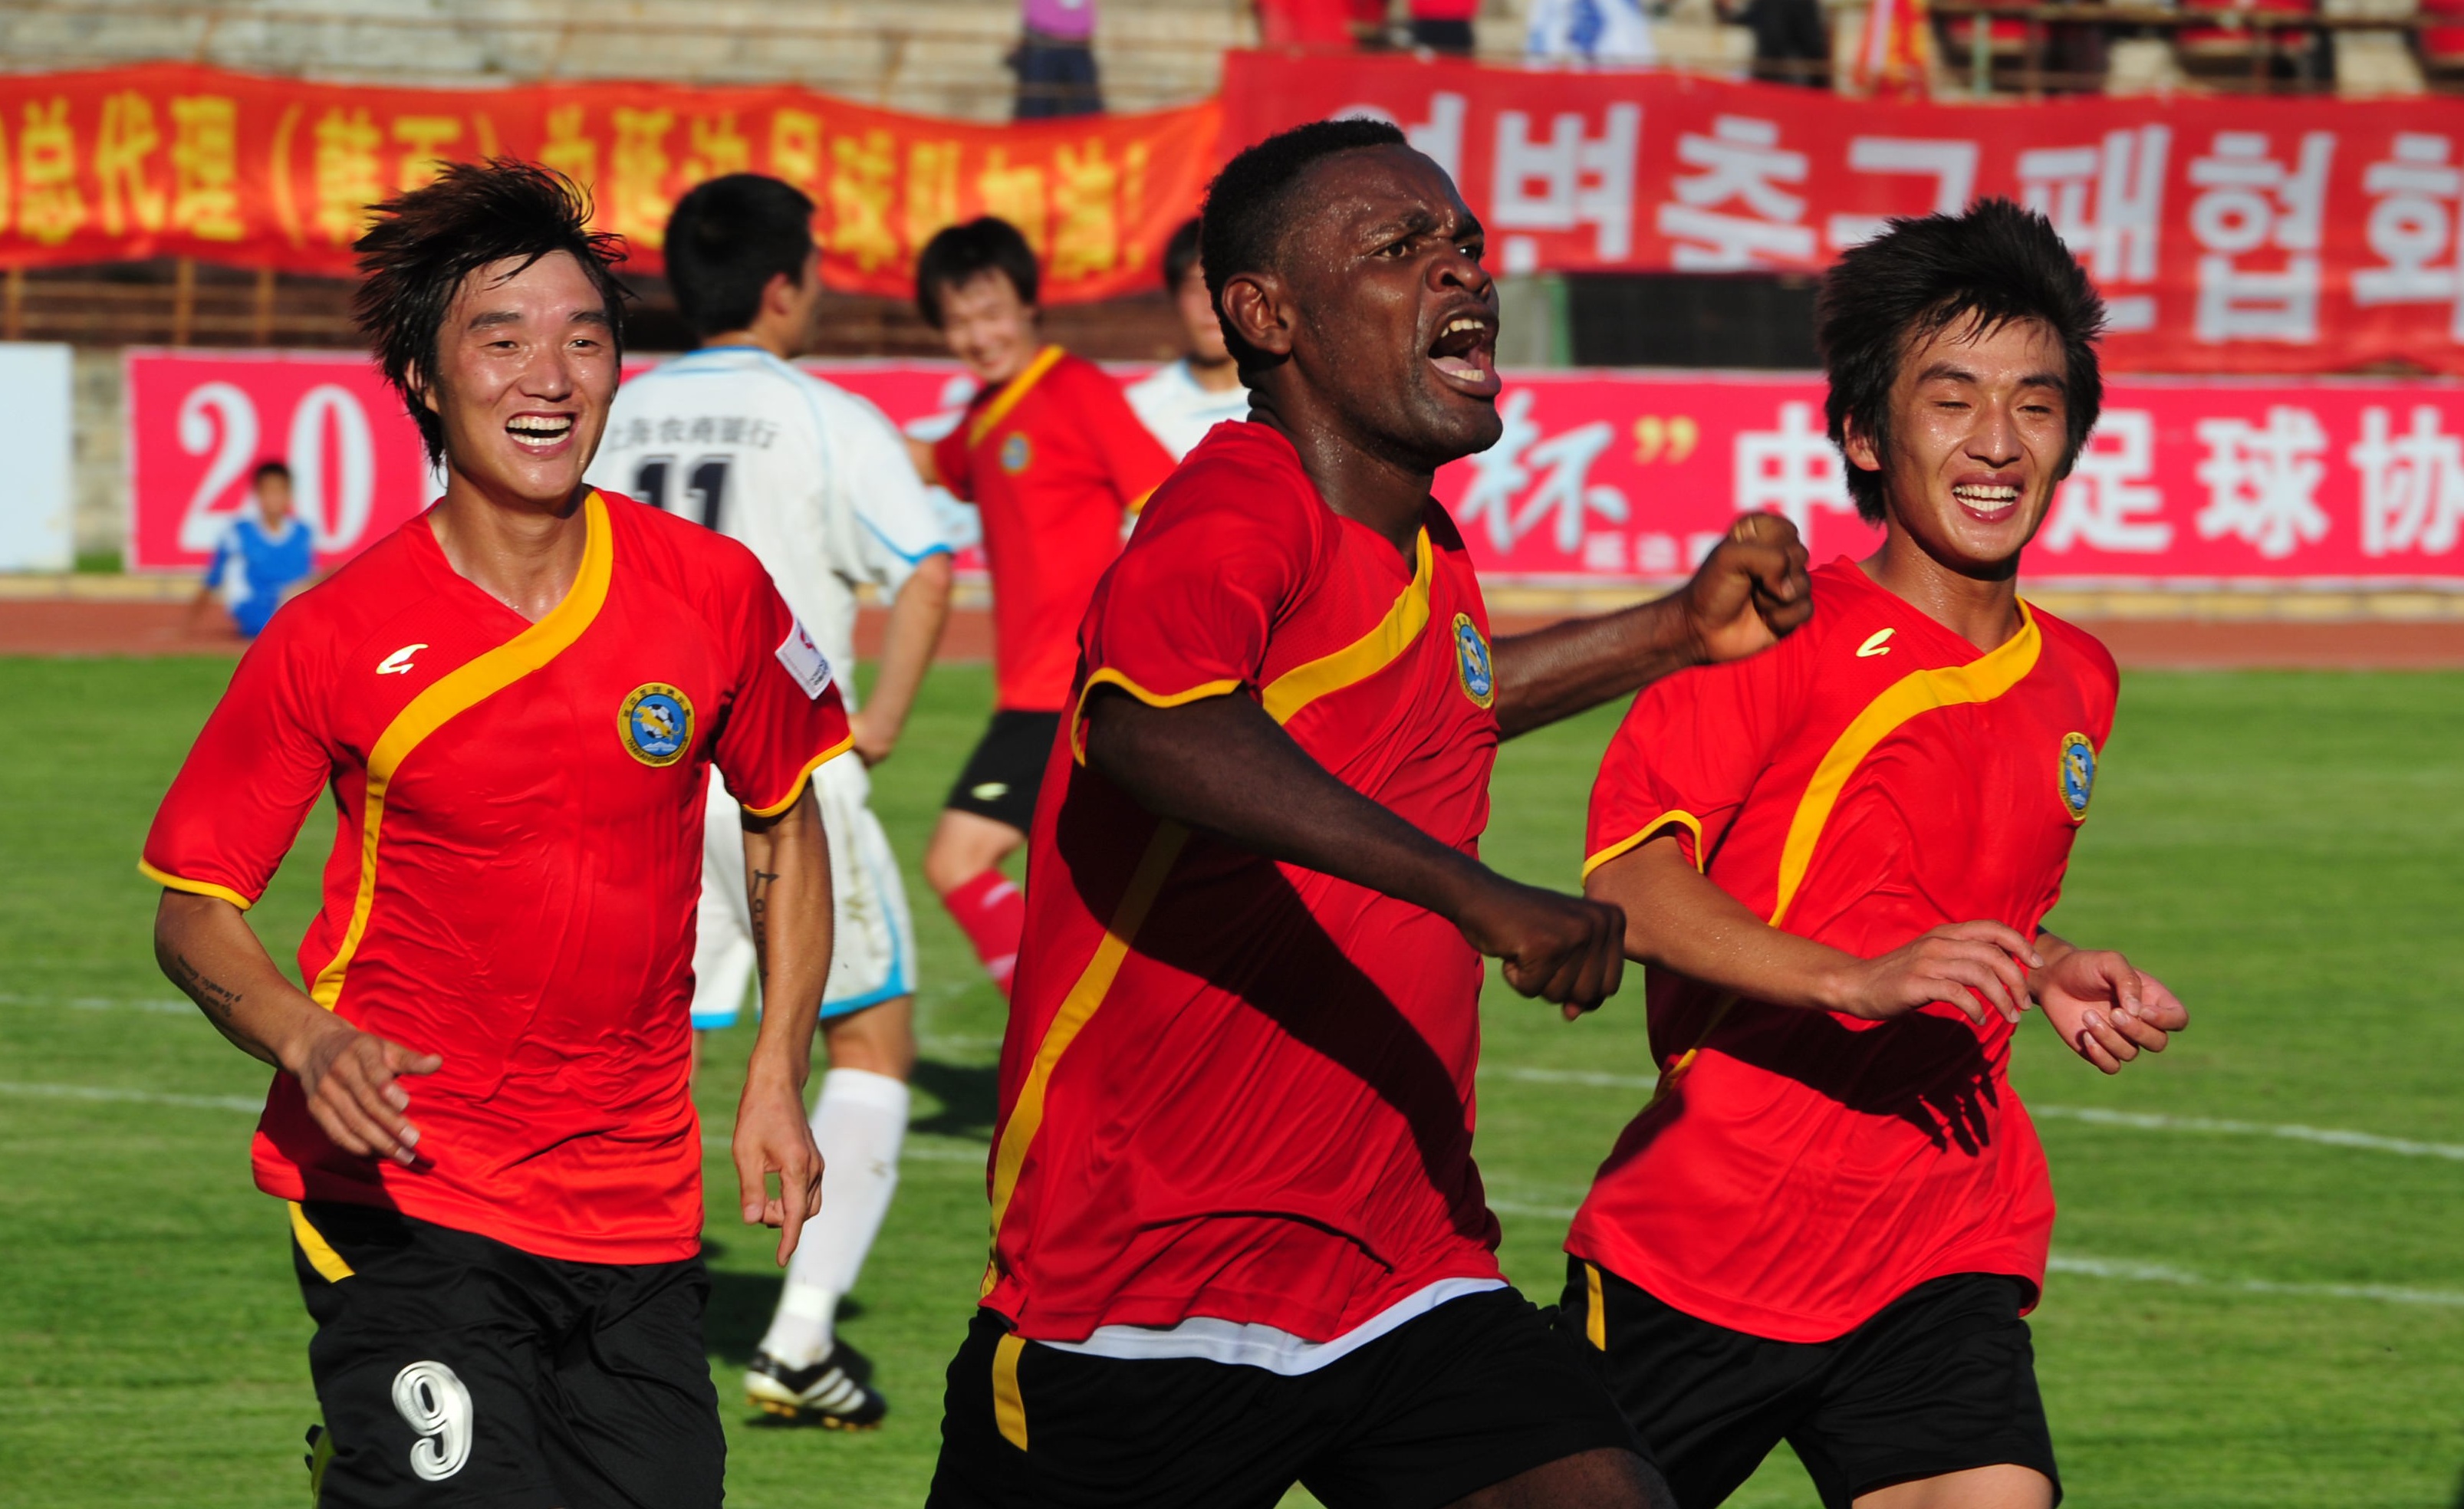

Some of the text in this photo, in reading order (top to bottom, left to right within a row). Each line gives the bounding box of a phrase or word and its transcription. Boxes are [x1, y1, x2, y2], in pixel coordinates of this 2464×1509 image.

[177, 381, 448, 554] 20
[632, 452, 735, 532] 11
[392, 1360, 473, 1481] 9
